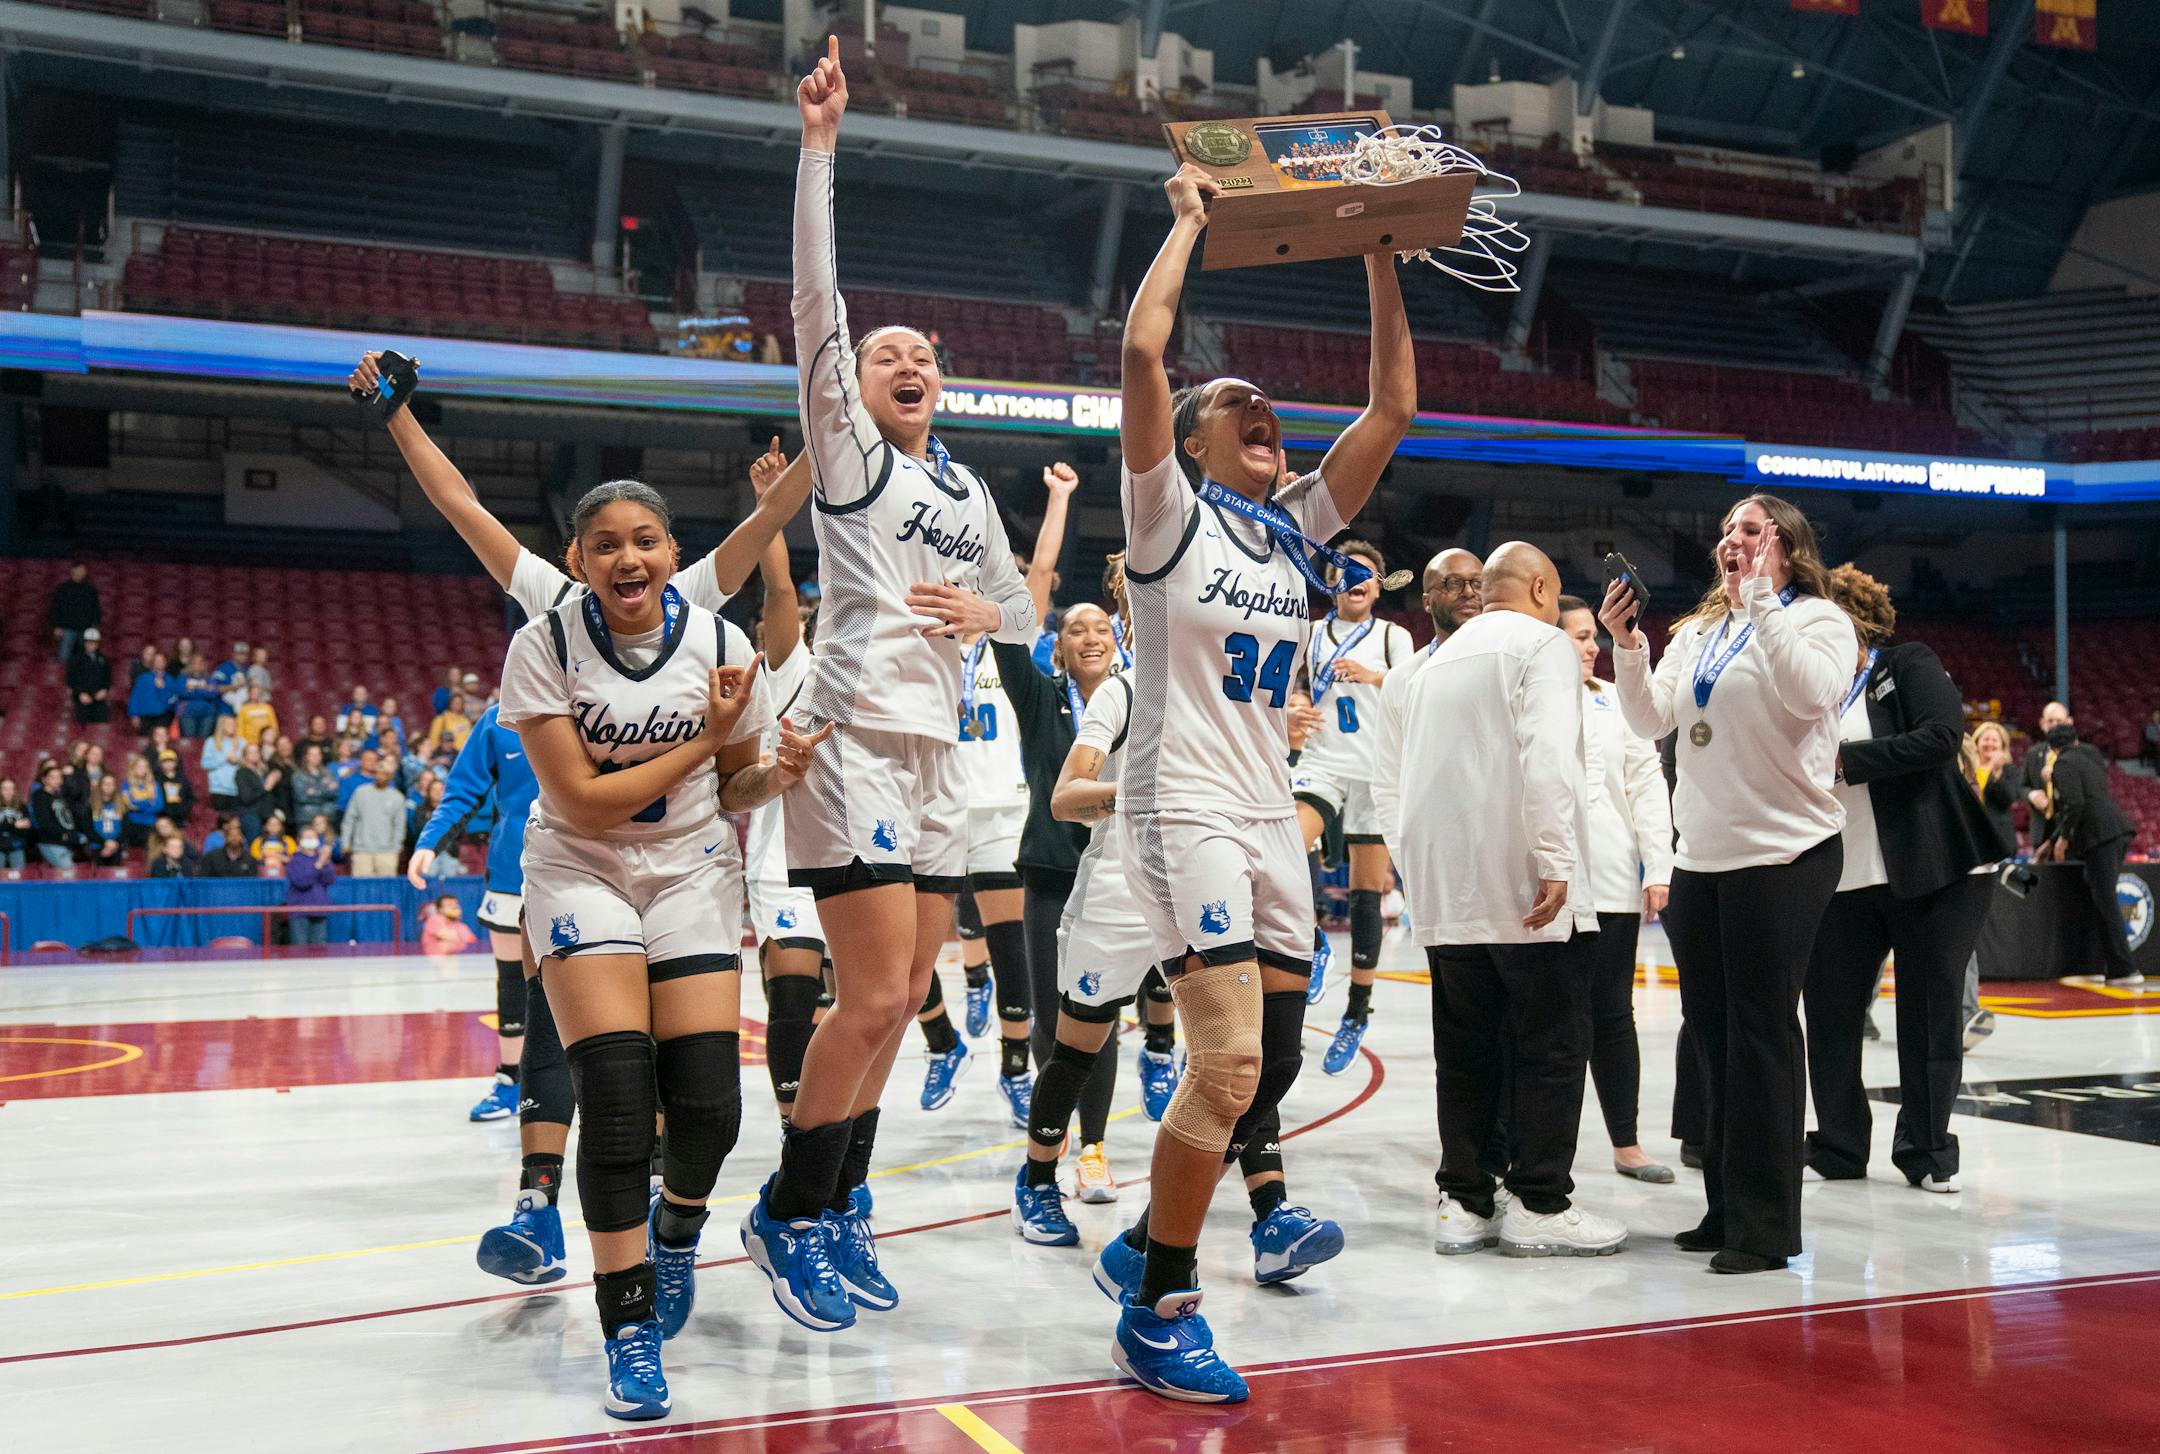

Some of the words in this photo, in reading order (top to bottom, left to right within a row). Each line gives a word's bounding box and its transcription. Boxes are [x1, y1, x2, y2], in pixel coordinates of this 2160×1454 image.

[1757, 455, 1928, 485] CONGRATULATIONS
[1224, 493, 1255, 513] STATE
[1281, 531, 1332, 594] CHAMPIONSHIPS
[1222, 631, 1298, 709] 34
[1713, 650, 1735, 671] STATE
[1336, 696, 1360, 733] 0
